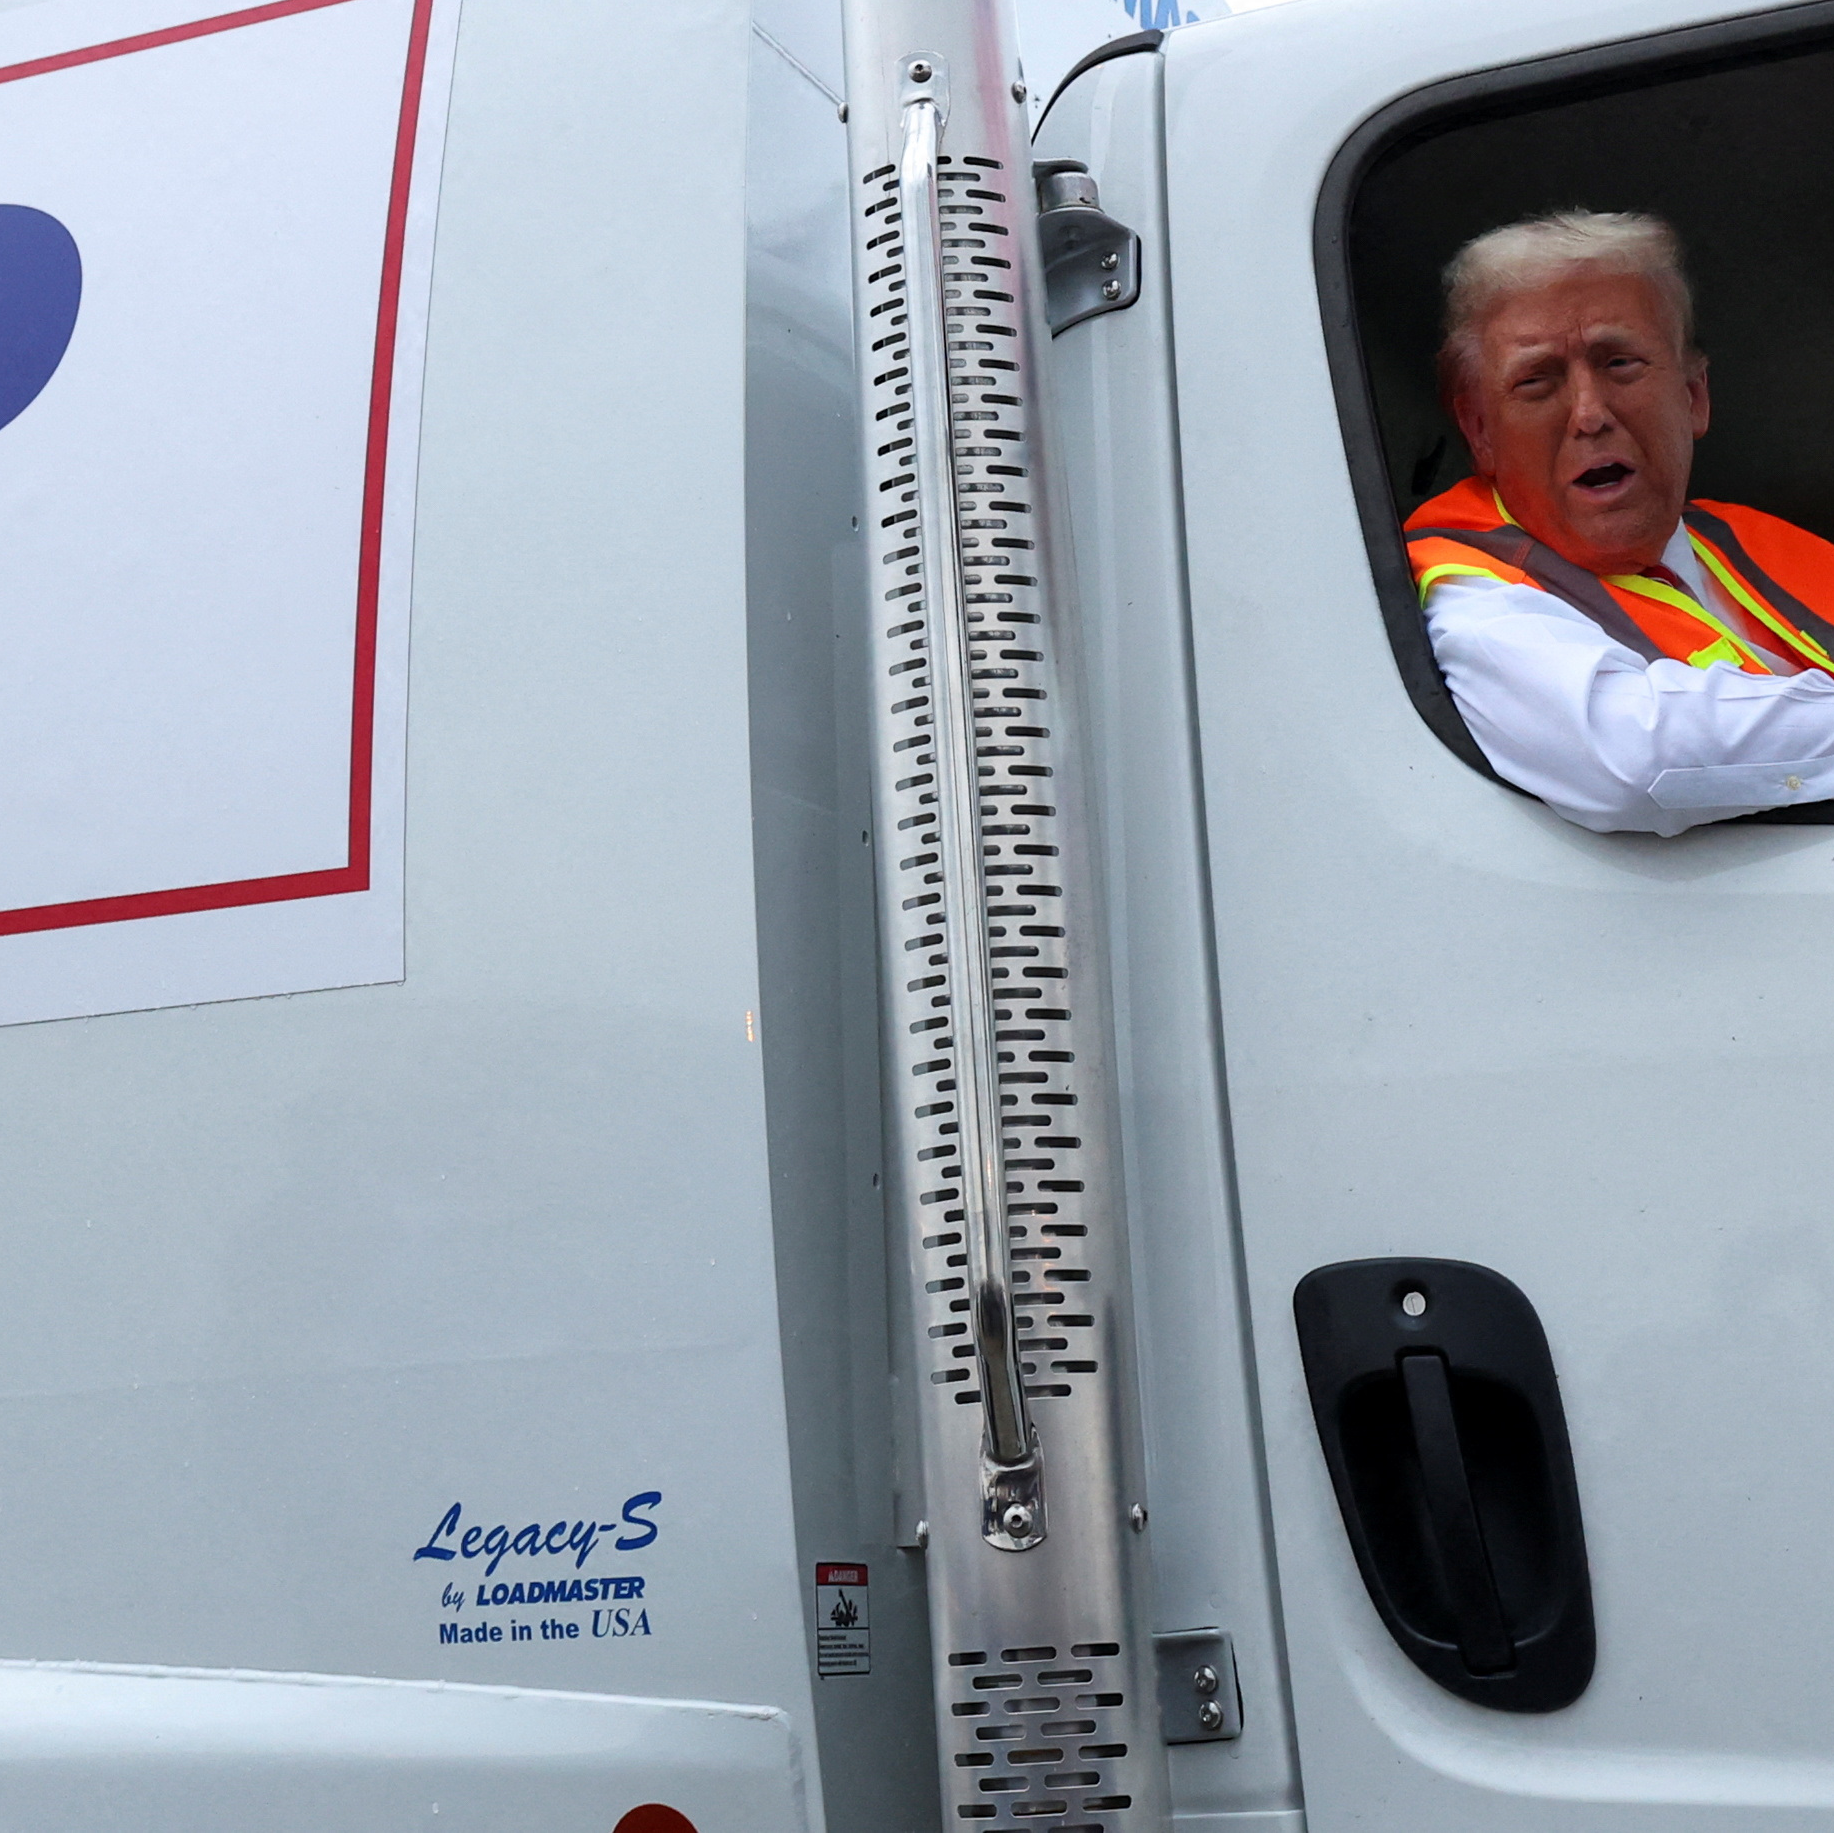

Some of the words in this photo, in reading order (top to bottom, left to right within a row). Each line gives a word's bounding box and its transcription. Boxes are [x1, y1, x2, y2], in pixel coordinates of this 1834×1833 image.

[412, 1490, 663, 1578] Legacy-S
[440, 1581, 465, 1613] by
[475, 1576, 646, 1607] LOADMASTER
[438, 1621, 503, 1645] Made
[510, 1619, 533, 1642] in
[540, 1618, 580, 1640] the
[591, 1607, 653, 1638] USA
